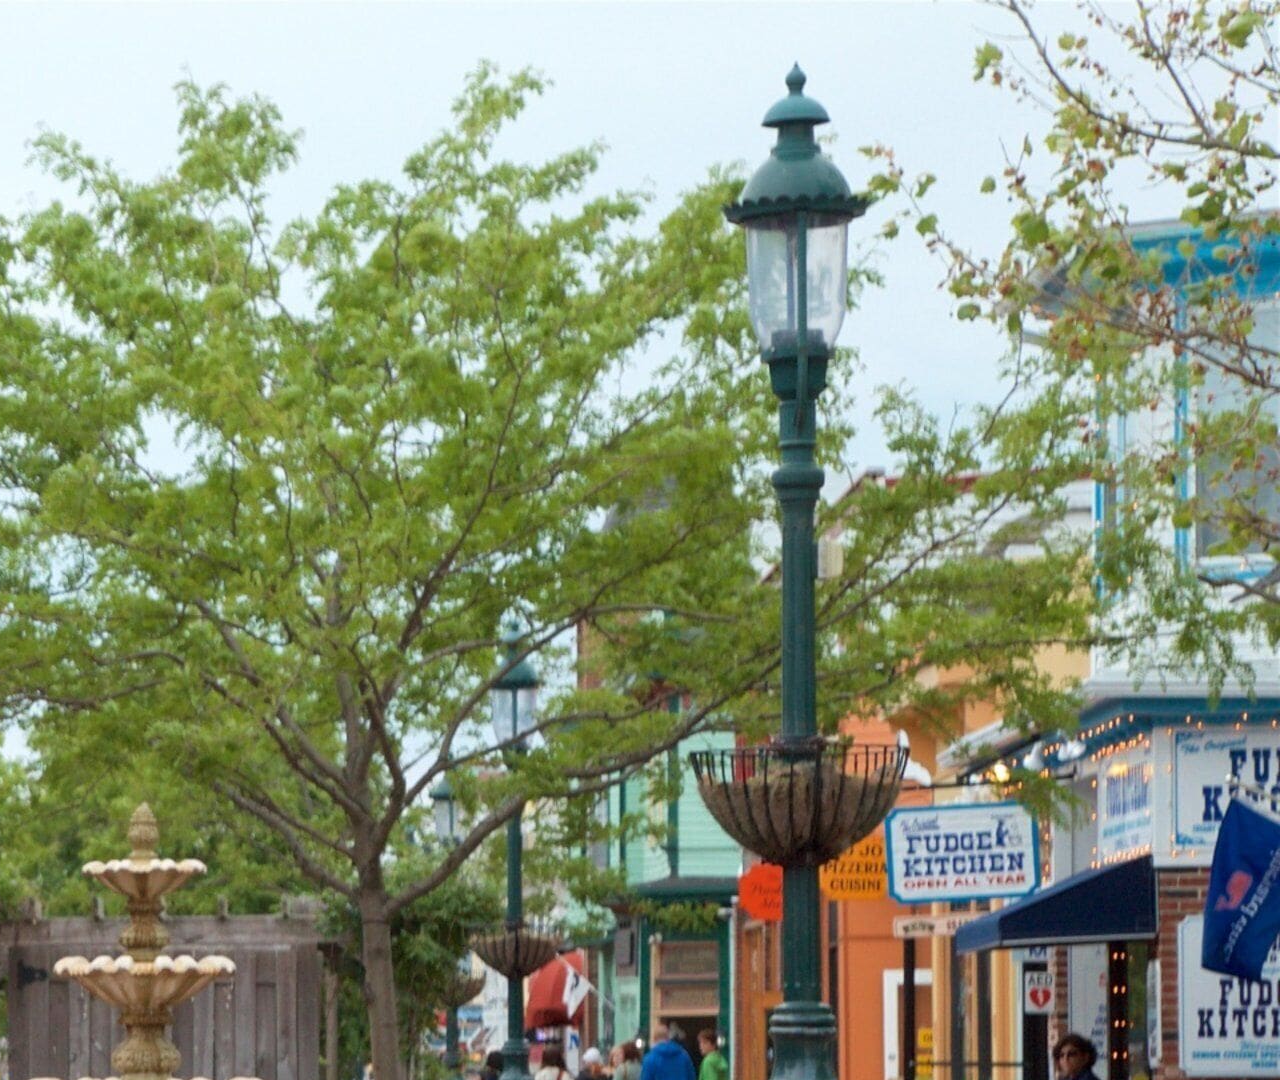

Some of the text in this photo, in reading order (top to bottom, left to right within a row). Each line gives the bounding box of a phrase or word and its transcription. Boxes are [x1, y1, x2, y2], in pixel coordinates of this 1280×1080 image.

[906, 831, 992, 854] FUDGE
[903, 852, 1025, 877] KITCHEN
[904, 874, 1026, 889] OPEN ALL YEAR
[1220, 979, 1280, 1007] FUD
